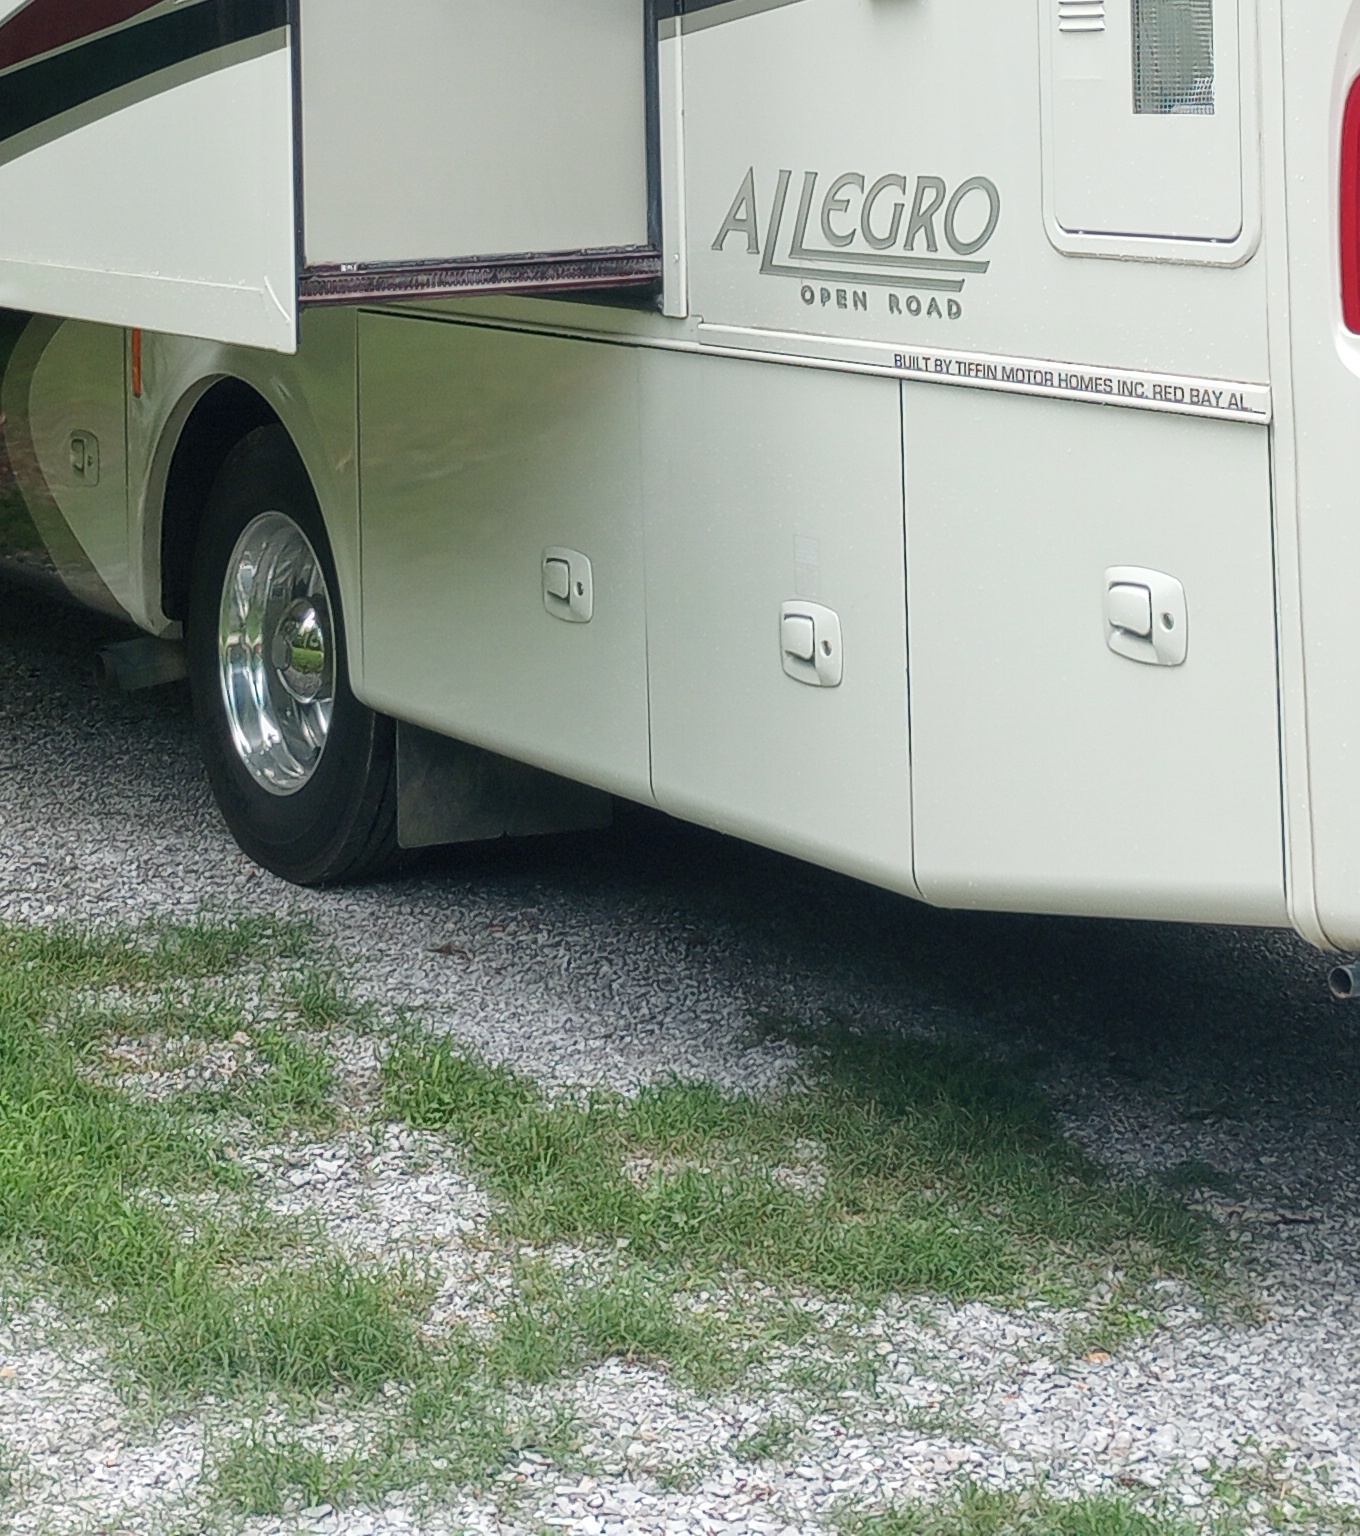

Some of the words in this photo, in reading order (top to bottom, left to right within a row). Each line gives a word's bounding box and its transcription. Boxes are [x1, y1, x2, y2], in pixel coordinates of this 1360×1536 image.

[711, 166, 1001, 292] ALLEGRO
[800, 284, 868, 312] OPEN
[888, 292, 963, 320] ROAD
[894, 353, 931, 372] BUILT
[934, 358, 953, 374] BY
[955, 360, 998, 380] TIFFIN
[1001, 366, 1053, 387] MOTOR
[1058, 372, 1113, 394] HOMES
[1117, 379, 1149, 399] INC.
[1152, 383, 1185, 402] RED
[1189, 388, 1223, 408] BAY
